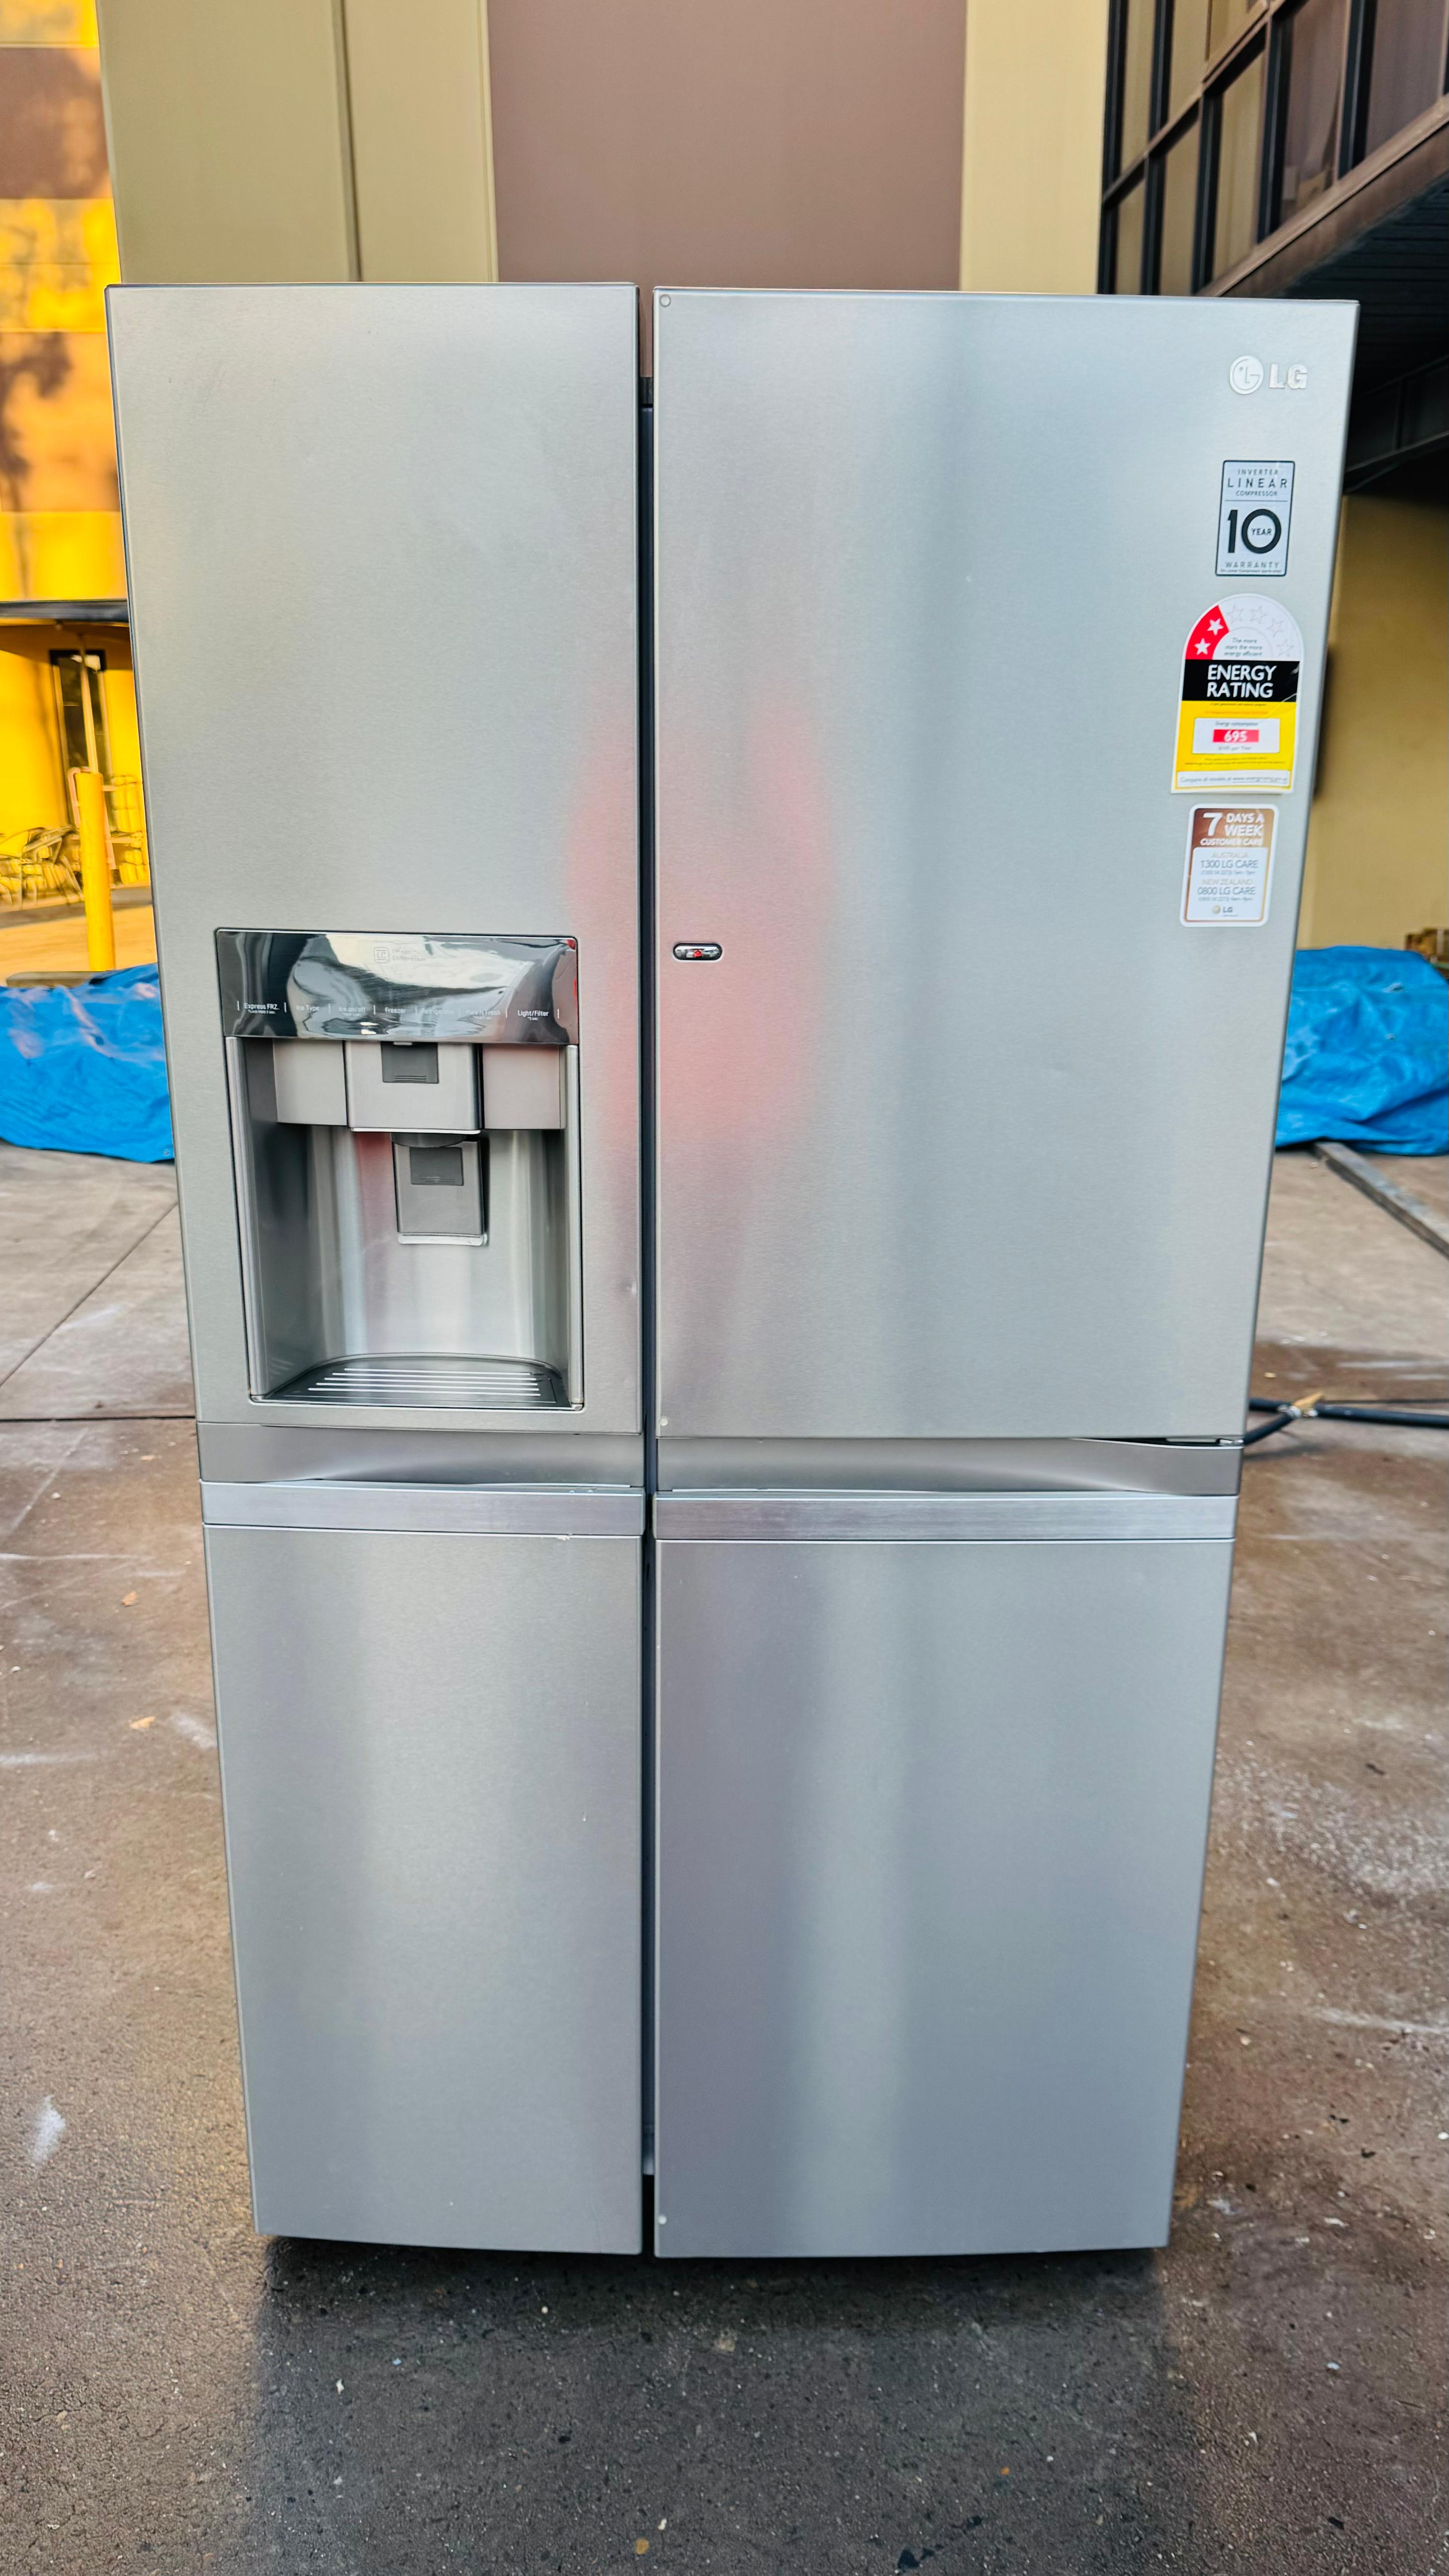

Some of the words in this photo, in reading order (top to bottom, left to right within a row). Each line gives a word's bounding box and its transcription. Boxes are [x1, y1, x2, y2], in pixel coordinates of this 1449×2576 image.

[1269, 363, 1307, 389] LG
[1228, 478, 1287, 488] LINEAR
[1227, 509, 1281, 554] 10
[1208, 664, 1277, 680] ENERGY
[1207, 682, 1273, 698] RATING
[1224, 730, 1247, 742] 695
[1203, 812, 1223, 836] 7
[1226, 813, 1255, 823] DAYS
[1256, 813, 1264, 823] A
[1224, 825, 1263, 836] WEEK
[1200, 838, 1242, 846] CUSTOMER
[1200, 860, 1221, 868] 1300
[1222, 860, 1233, 868] LG
[1235, 860, 1259, 868] CARE
[1197, 887, 1218, 895] 0800
[1219, 887, 1231, 895] LG
[1233, 887, 1256, 895] CARE
